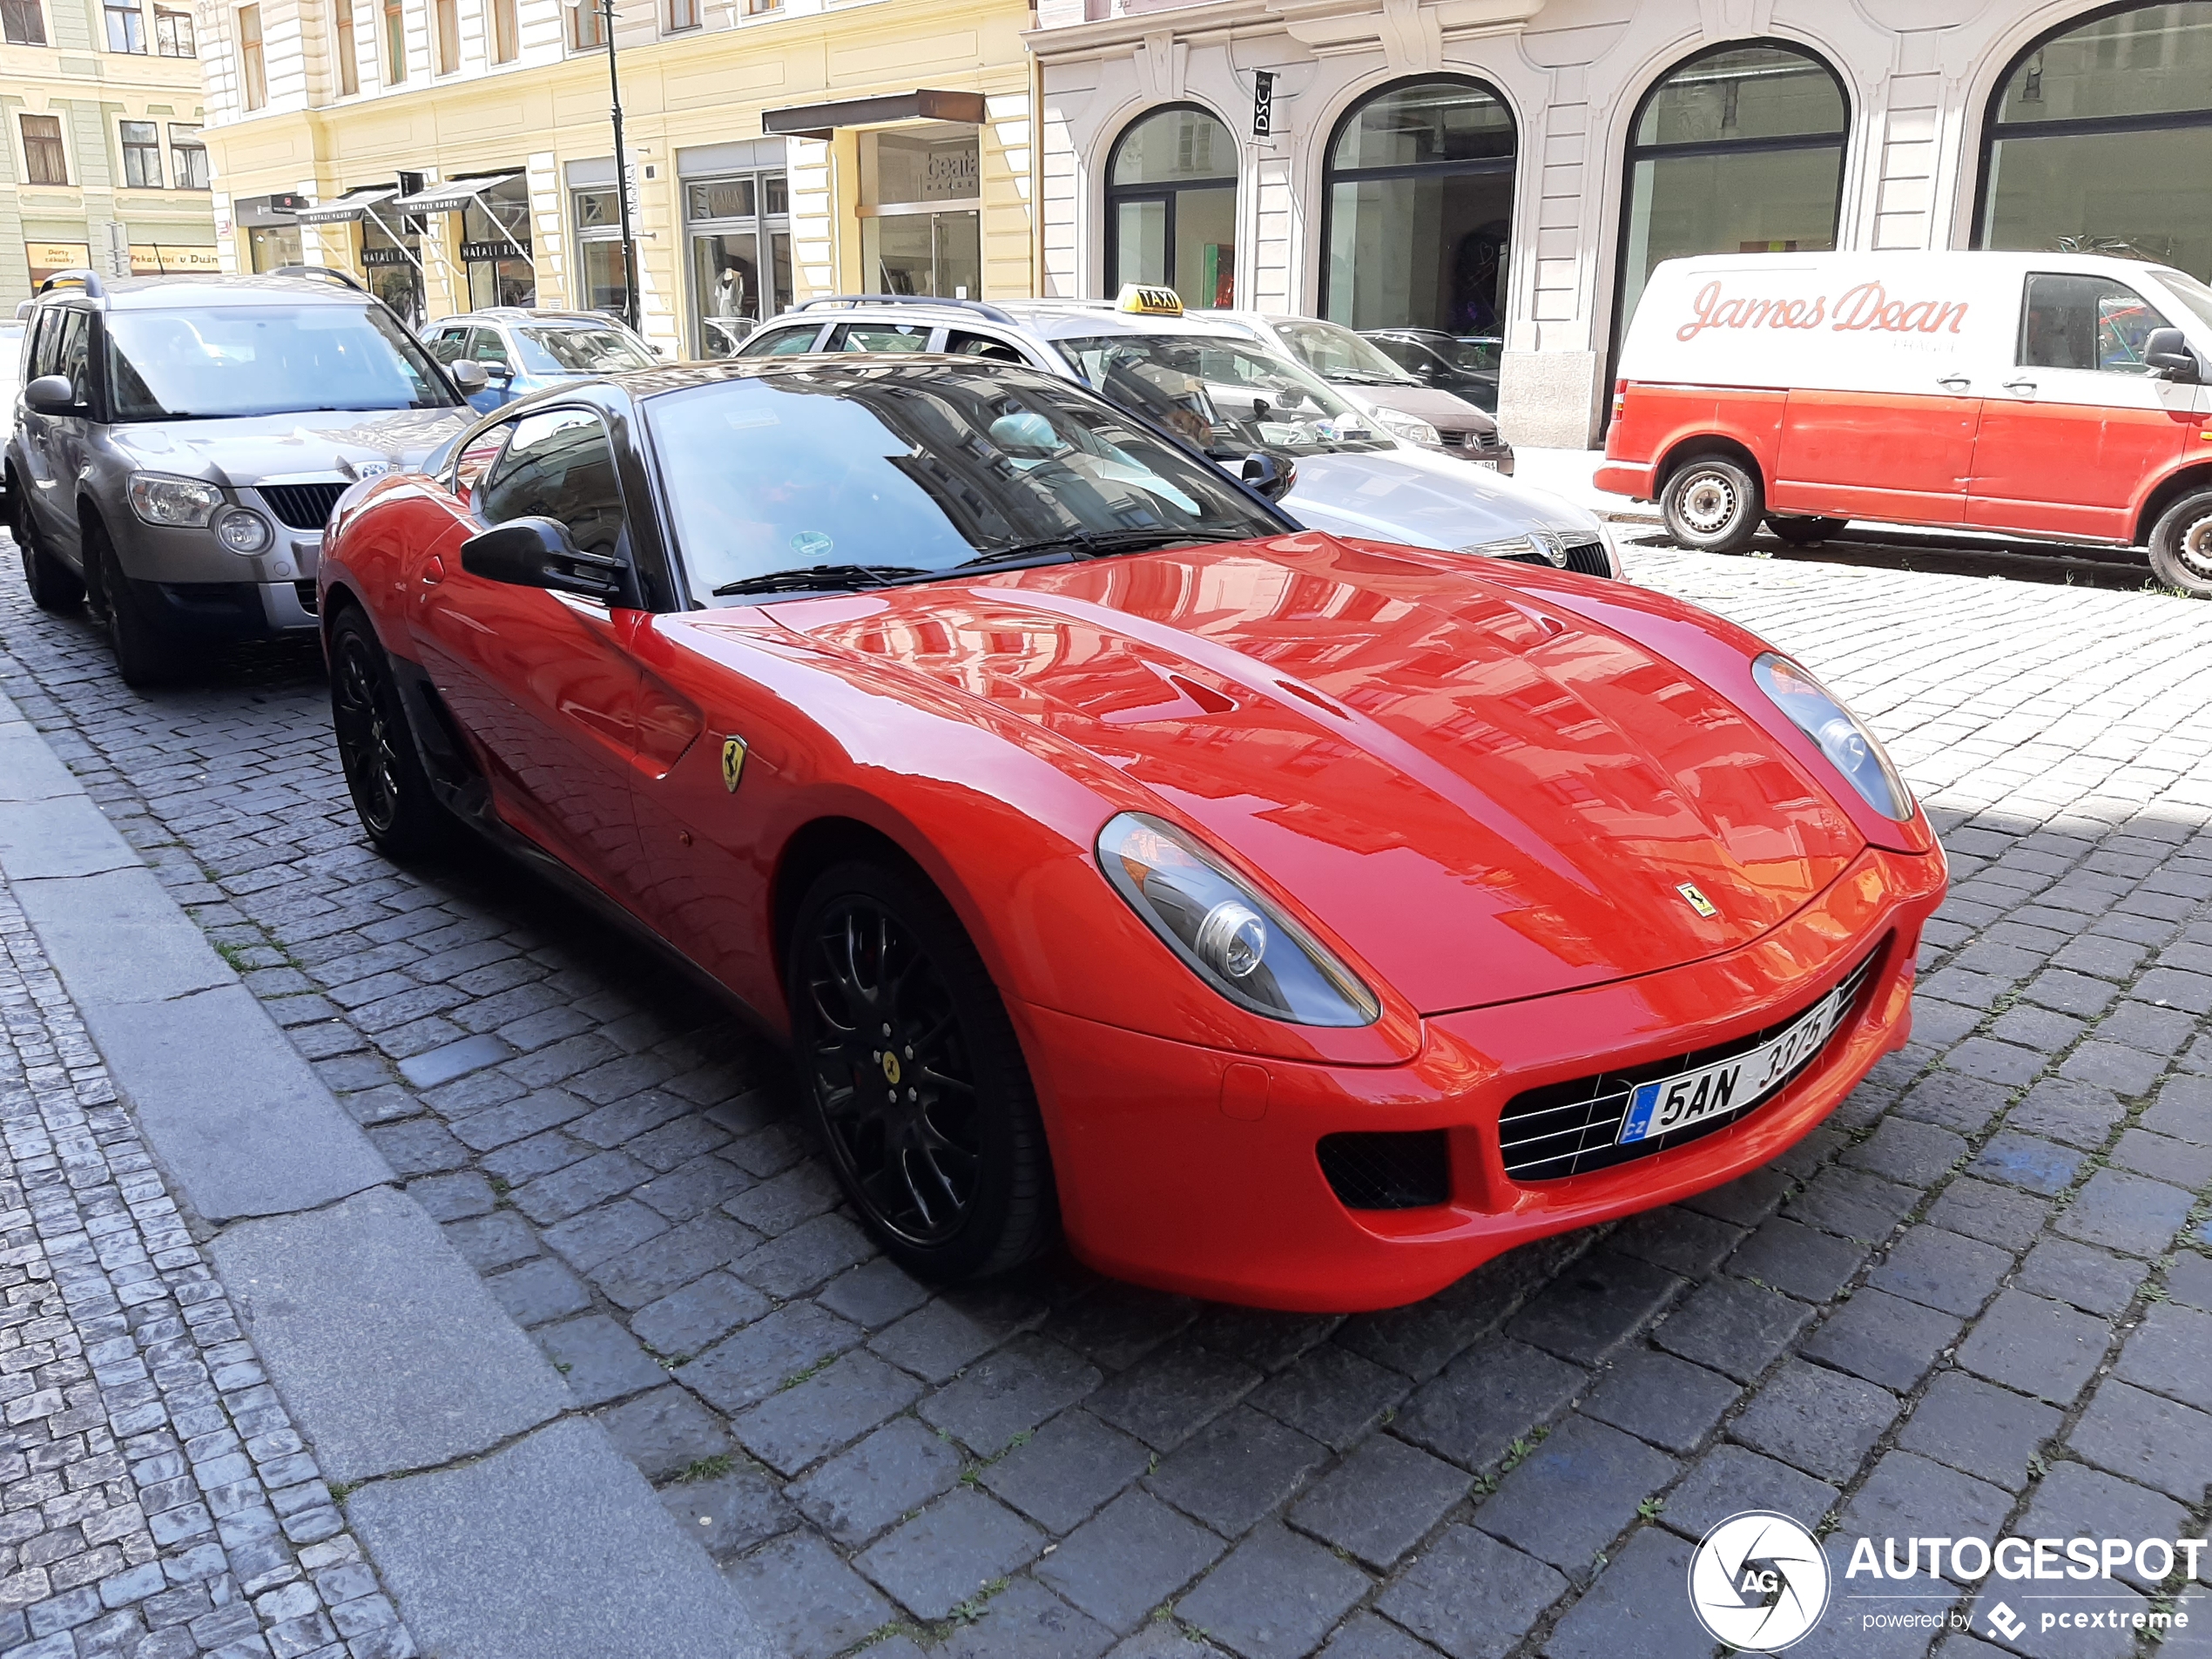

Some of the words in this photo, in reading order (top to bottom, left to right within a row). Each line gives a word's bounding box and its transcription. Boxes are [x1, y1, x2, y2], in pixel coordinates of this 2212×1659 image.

[1256, 89, 1271, 131] DSC
[131, 253, 174, 263] Pekařtví
[190, 253, 218, 263] Dušn
[362, 251, 395, 262] NATALI
[462, 245, 497, 257] NATALI
[503, 243, 529, 255] RUDE
[1139, 290, 1177, 308] TAXI
[1676, 280, 1826, 341] James
[1831, 280, 1968, 334] Dean
[1661, 1064, 1742, 1125] 5AN
[1759, 1009, 1827, 1088] 3375
[1625, 1120, 1647, 1136] CZ
